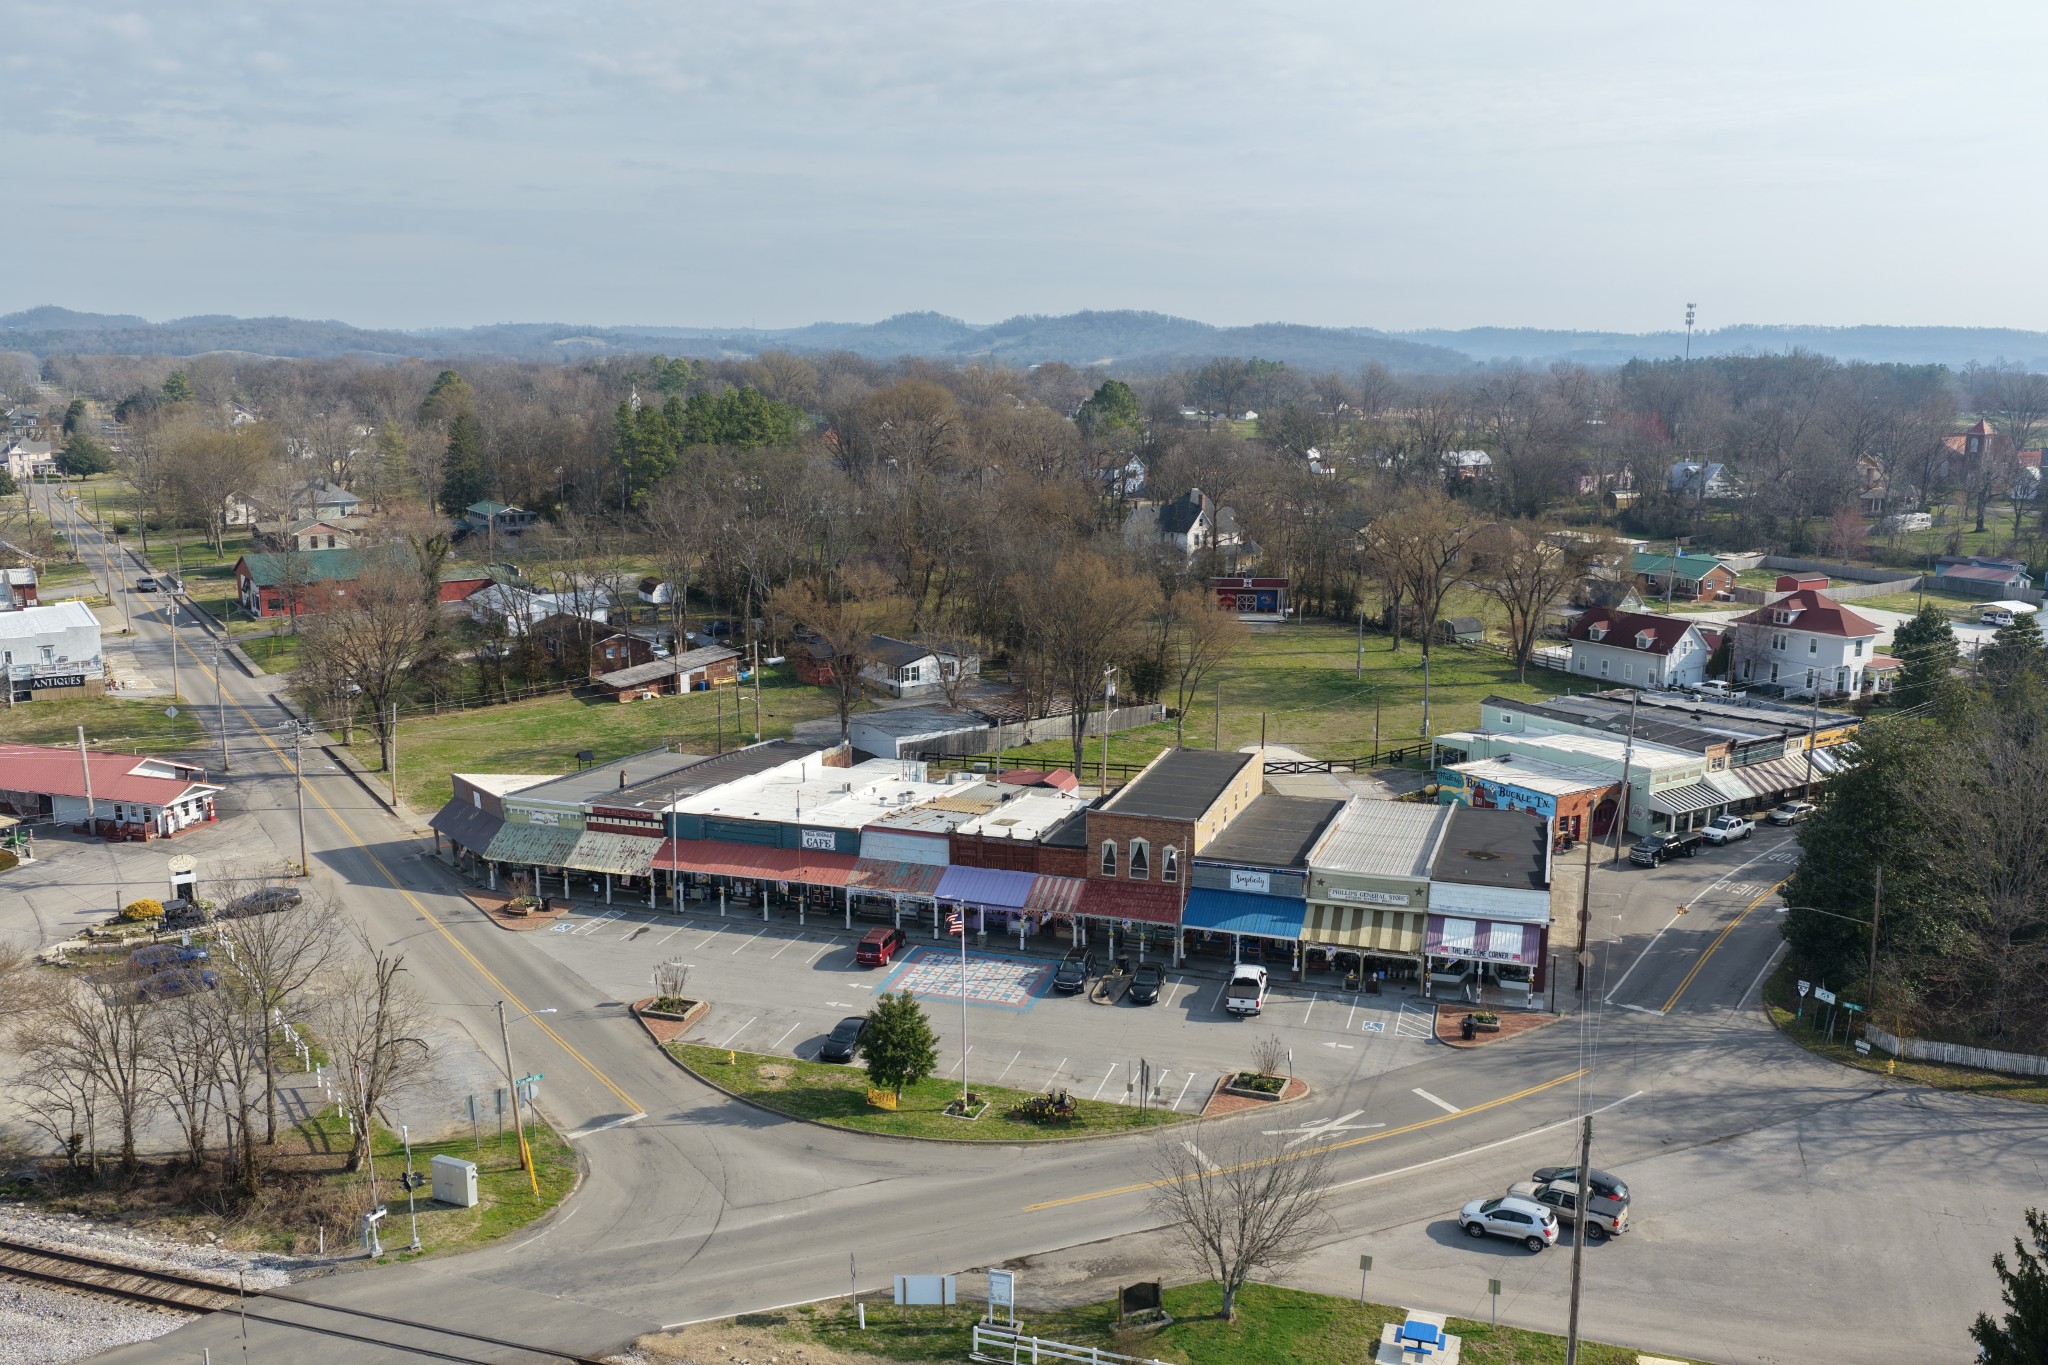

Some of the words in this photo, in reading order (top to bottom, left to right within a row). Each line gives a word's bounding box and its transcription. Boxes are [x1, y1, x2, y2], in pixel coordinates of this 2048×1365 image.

[33, 676, 81, 688] ANTIQUES
[1498, 786, 1532, 803] BUCKLE
[806, 837, 832, 848] CAFE
[1235, 873, 1265, 888] Simplicity
[1360, 891, 1387, 900] GENERAL
[1389, 894, 1406, 902] STORE
[1452, 946, 1463, 955] THE
[1464, 948, 1487, 958] WELCOME
[1488, 950, 1509, 960] CORNER
